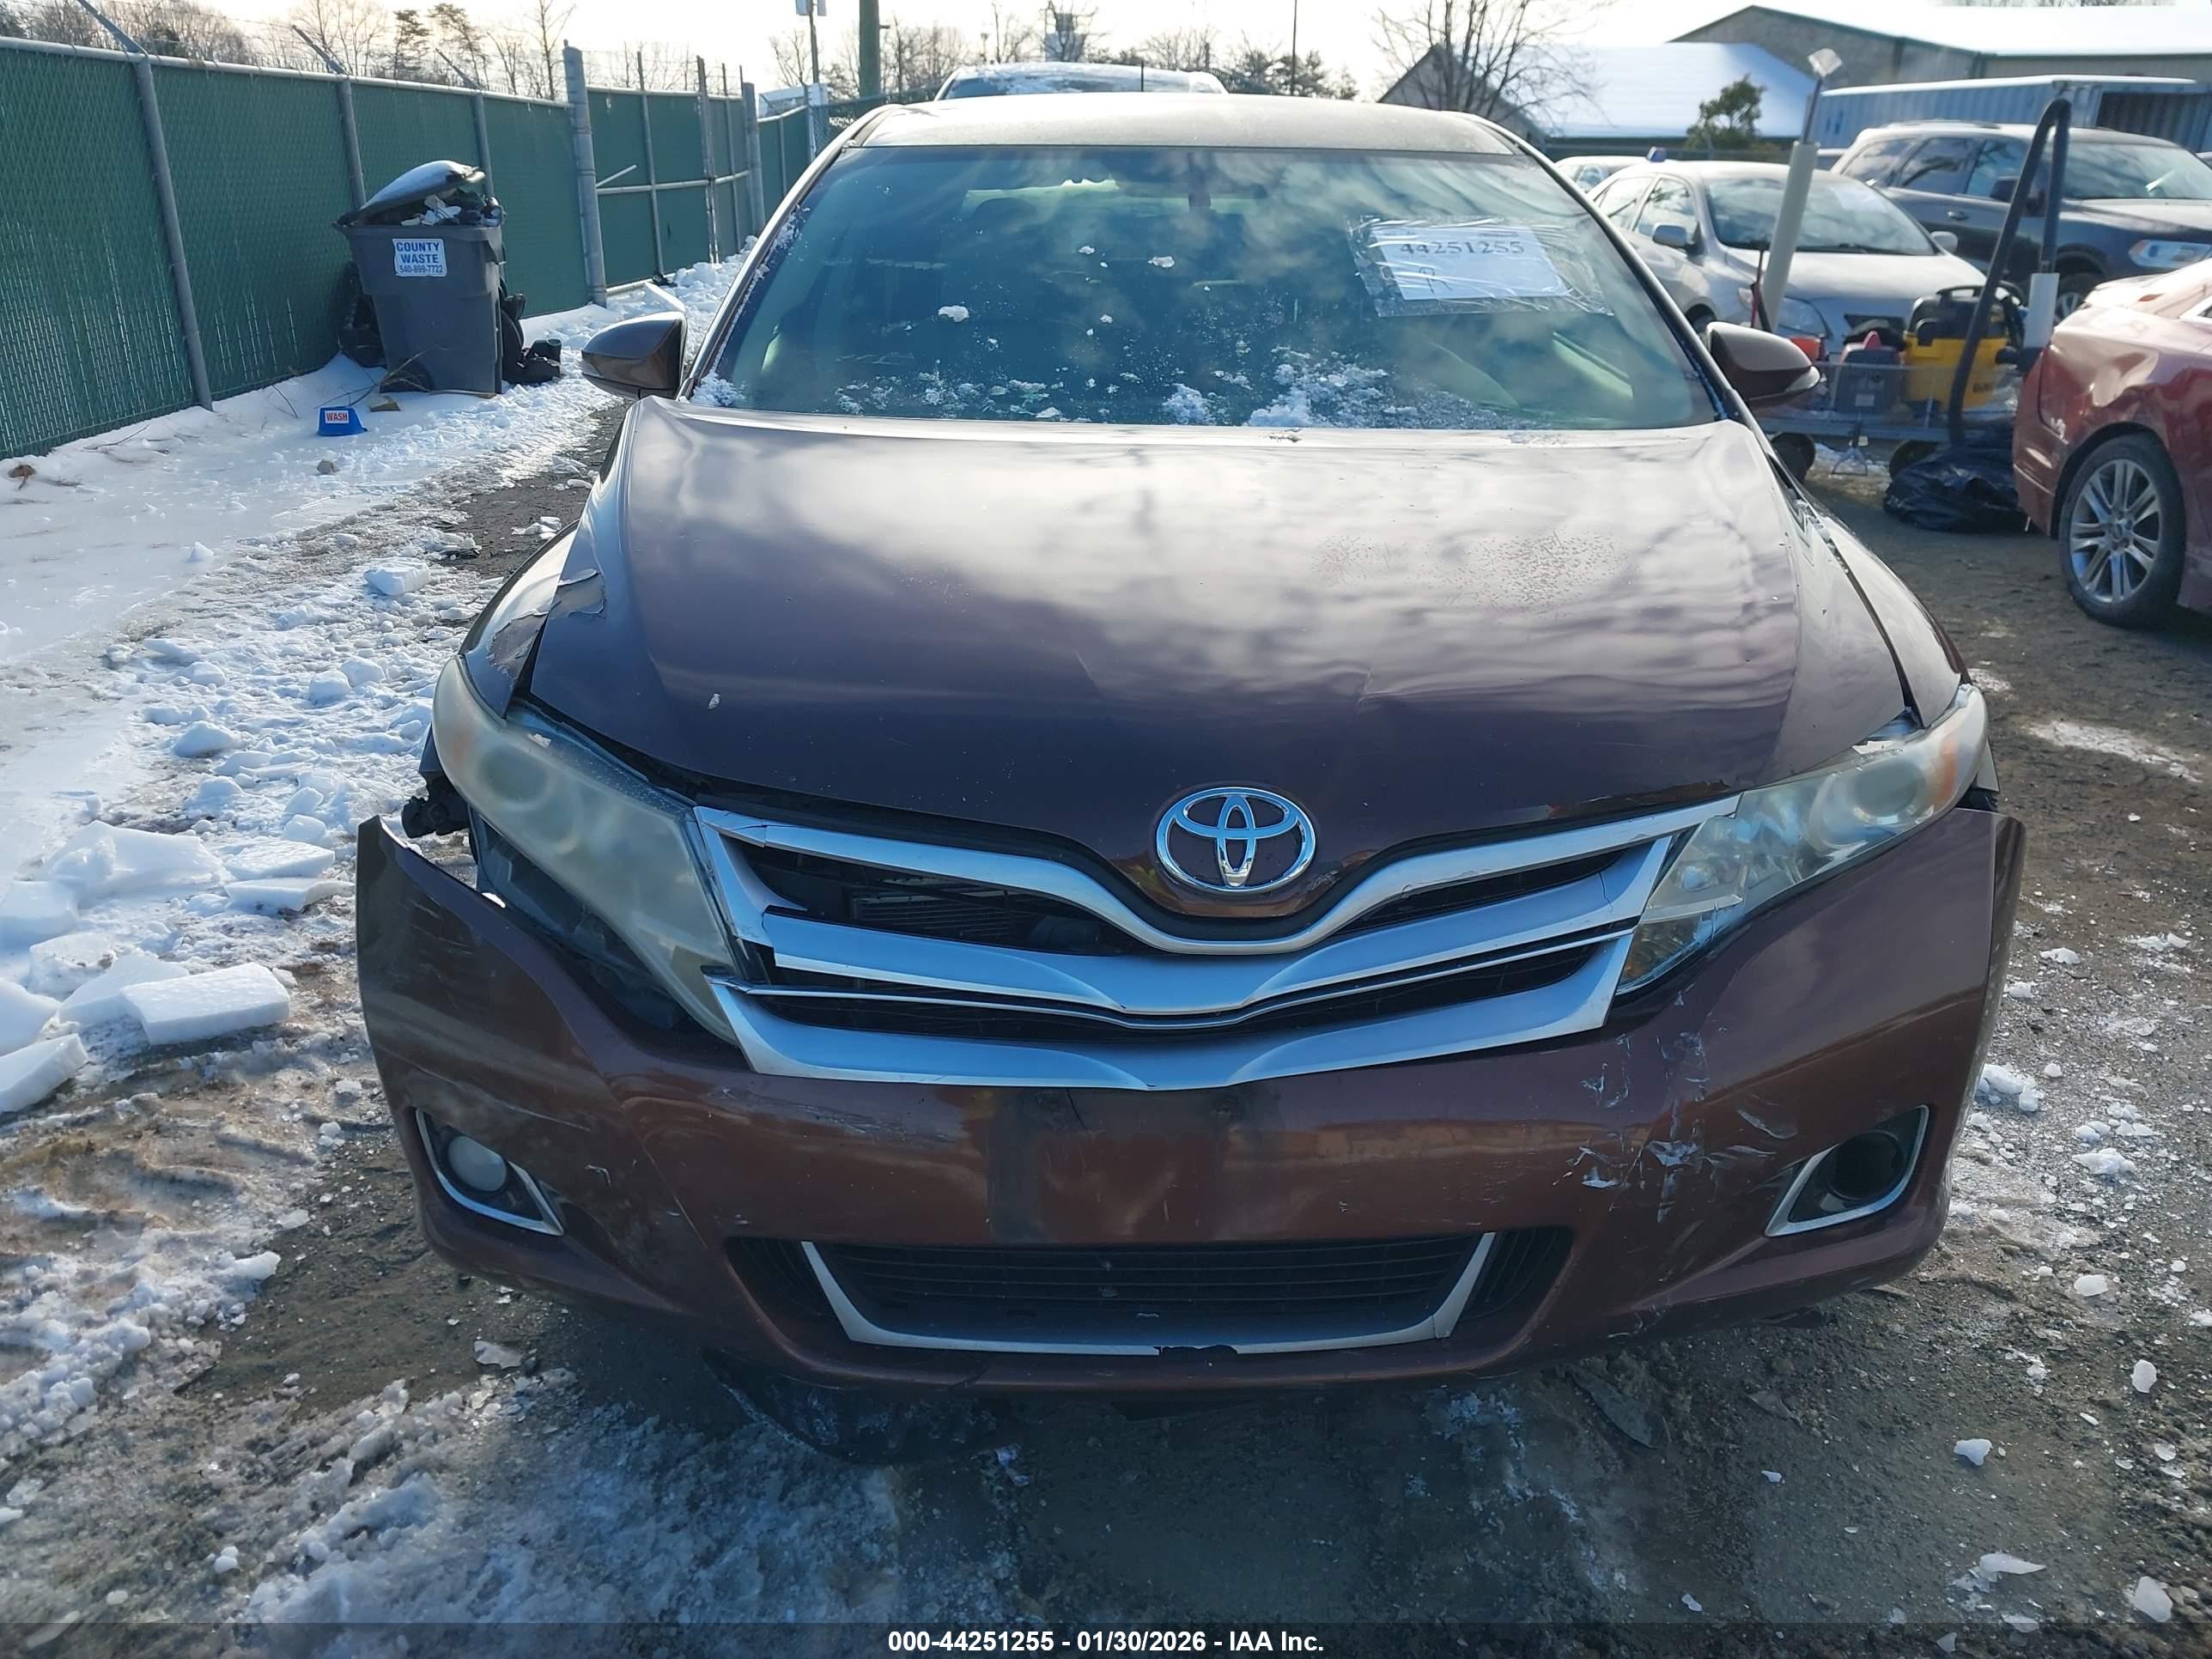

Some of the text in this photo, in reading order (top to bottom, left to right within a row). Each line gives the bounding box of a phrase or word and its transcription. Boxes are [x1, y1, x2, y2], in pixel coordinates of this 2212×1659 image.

[396, 241, 440, 252] COUNTY
[1400, 240, 1525, 255] 44251255
[400, 253, 440, 264] WASTE
[325, 411, 348, 421] WASH
